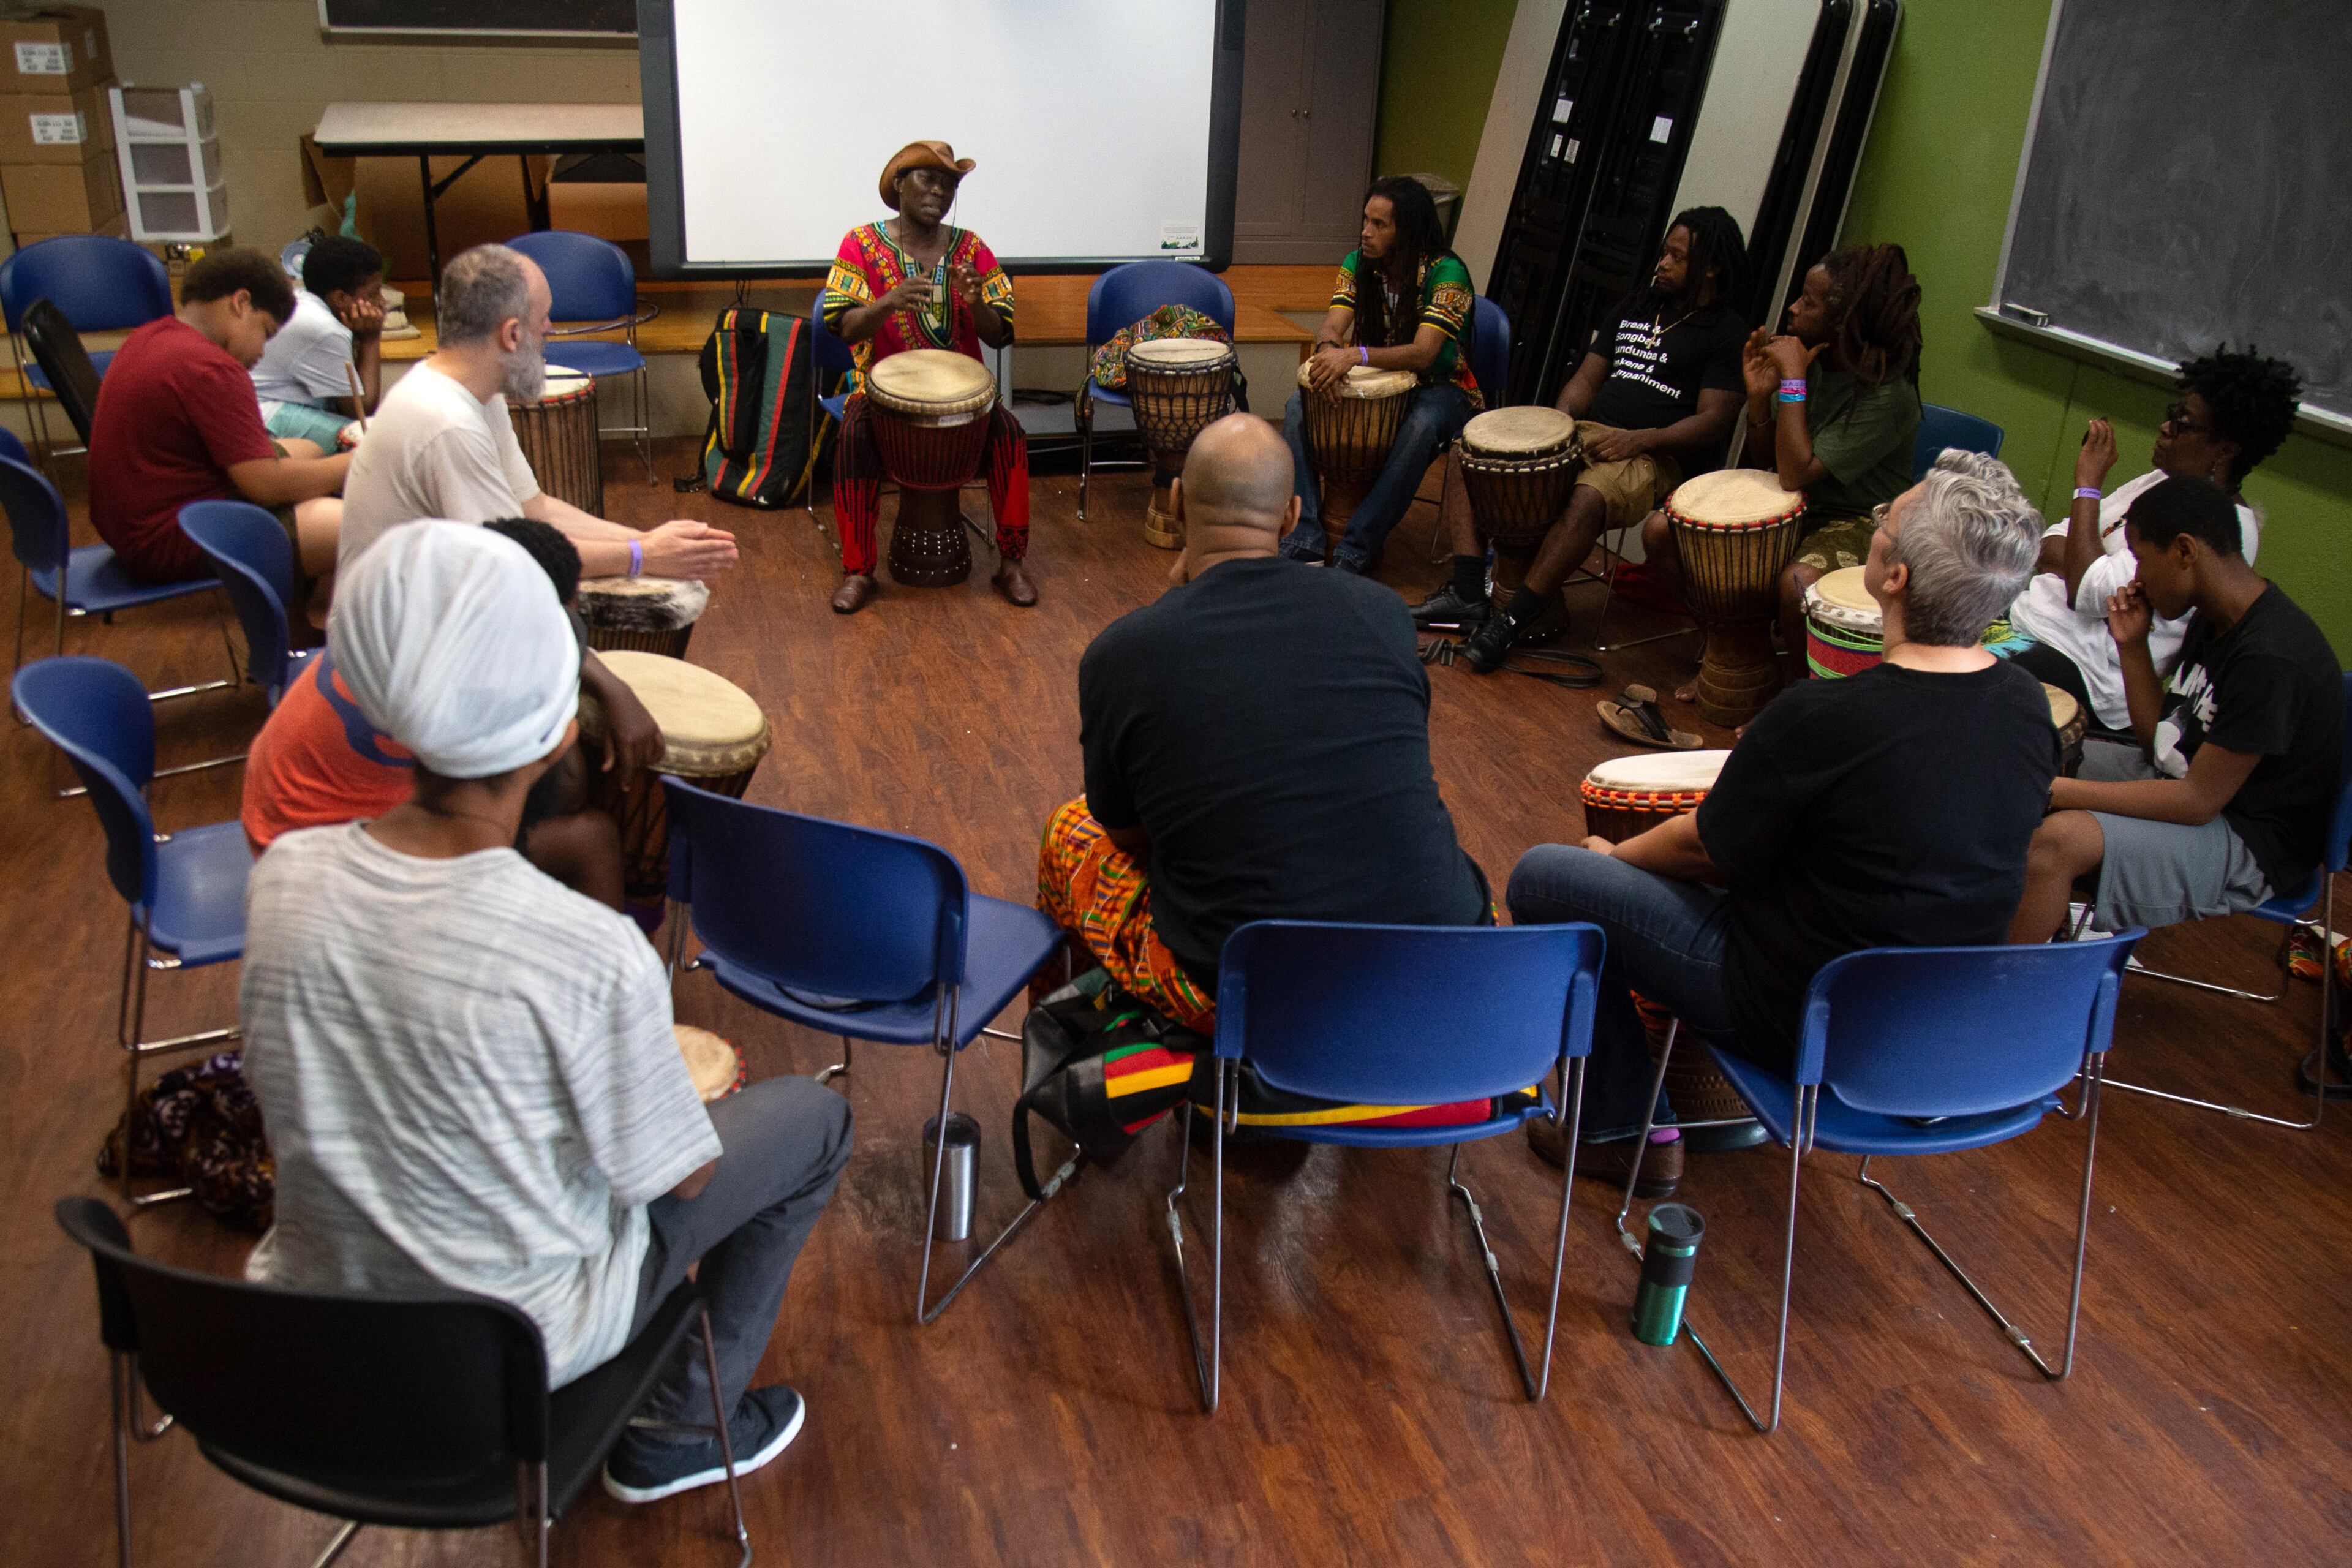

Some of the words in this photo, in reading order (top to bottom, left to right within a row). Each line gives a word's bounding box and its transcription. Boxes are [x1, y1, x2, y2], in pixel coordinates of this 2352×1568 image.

[1619, 319, 1651, 331] Break
[1652, 325, 1662, 334] &
[1654, 337, 1662, 347] &
[1615, 345, 1657, 361] undunba
[1659, 353, 1668, 363] &
[1646, 364, 1654, 373] &
[1611, 369, 1681, 399] mpaniment
